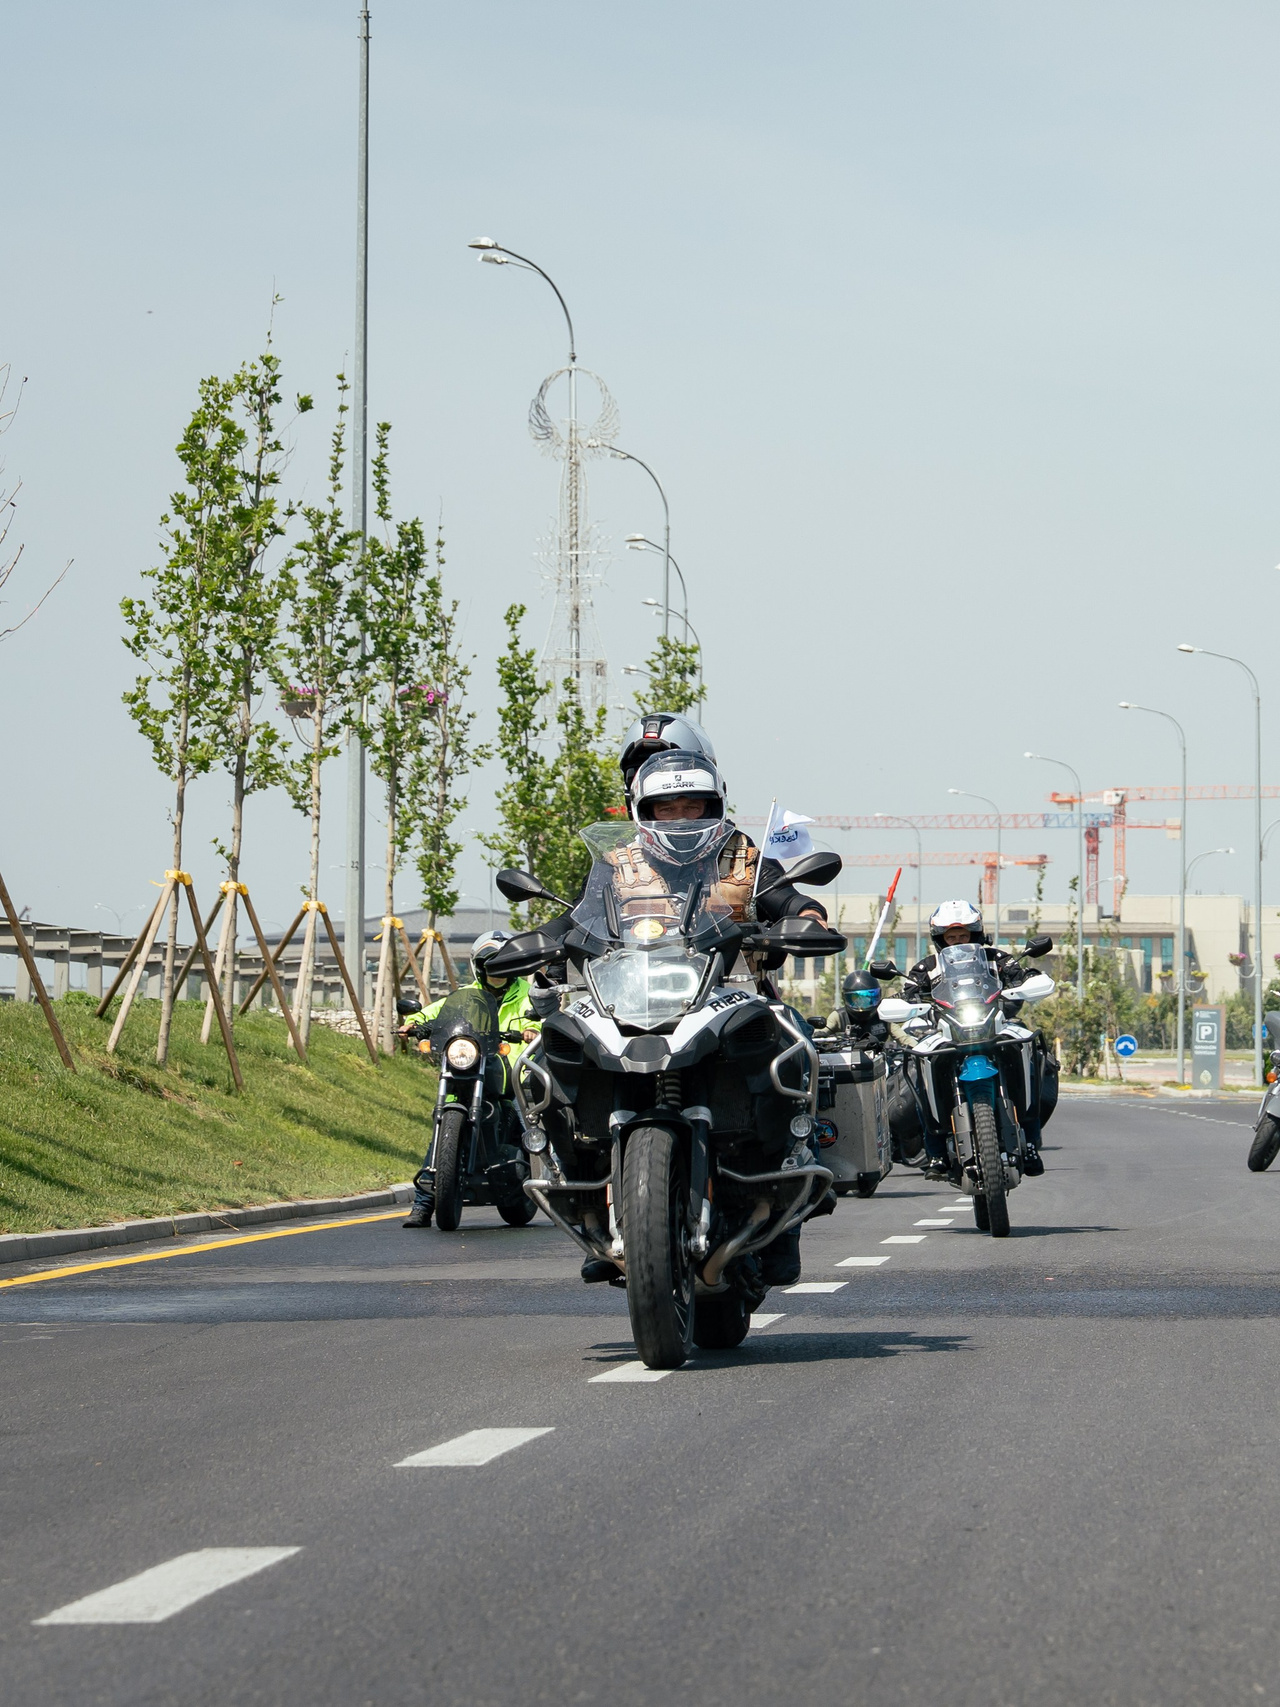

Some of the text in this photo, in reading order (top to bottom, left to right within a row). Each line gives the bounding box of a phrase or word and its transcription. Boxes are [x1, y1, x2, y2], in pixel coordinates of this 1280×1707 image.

[662, 781, 695, 790] SHARK
[708, 990, 751, 1012] R1200
[1200, 1025, 1213, 1040] P
